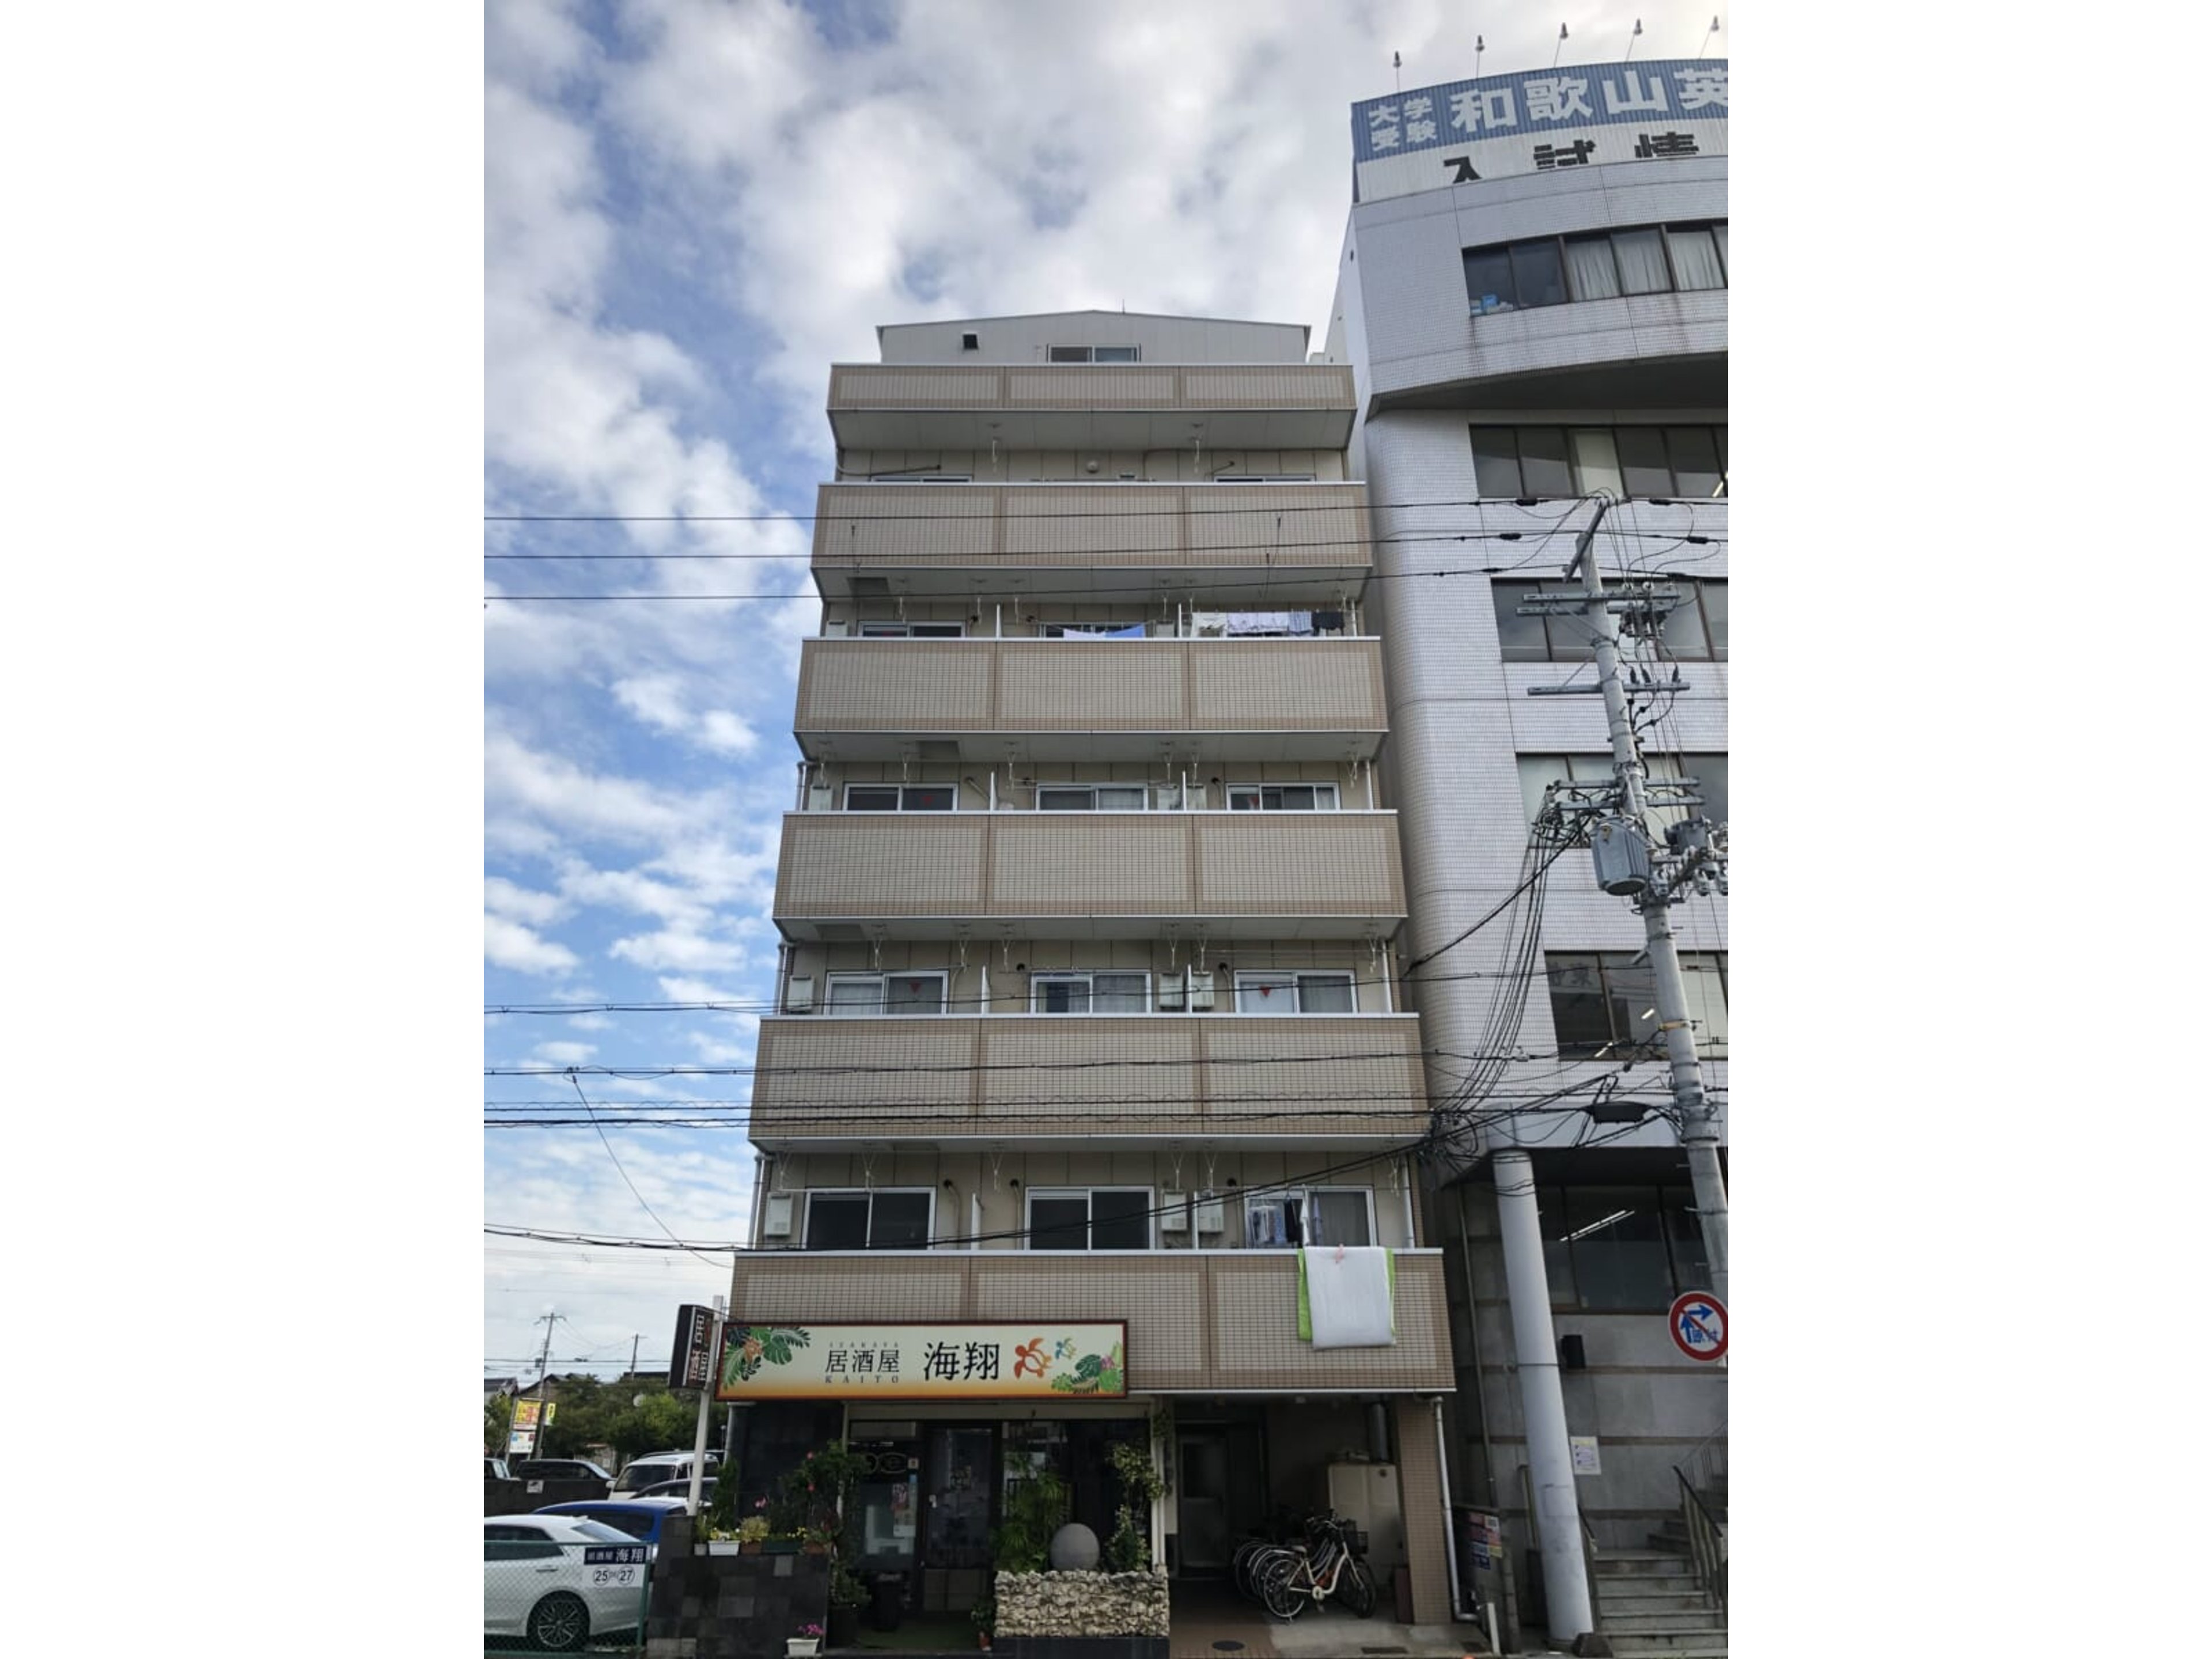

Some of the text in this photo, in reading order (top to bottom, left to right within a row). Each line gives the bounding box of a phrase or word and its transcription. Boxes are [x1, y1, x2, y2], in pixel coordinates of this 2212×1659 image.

[1368, 97, 1433, 128] 大学
[1449, 67, 1728, 133] 和歌山英
[1371, 120, 1437, 152] 受験
[825, 1341, 1000, 1381] 居酒屋 海翔
[825, 1374, 899, 1384] KAITO
[594, 1570, 608, 1581] 25
[618, 1570, 634, 1581] 27
